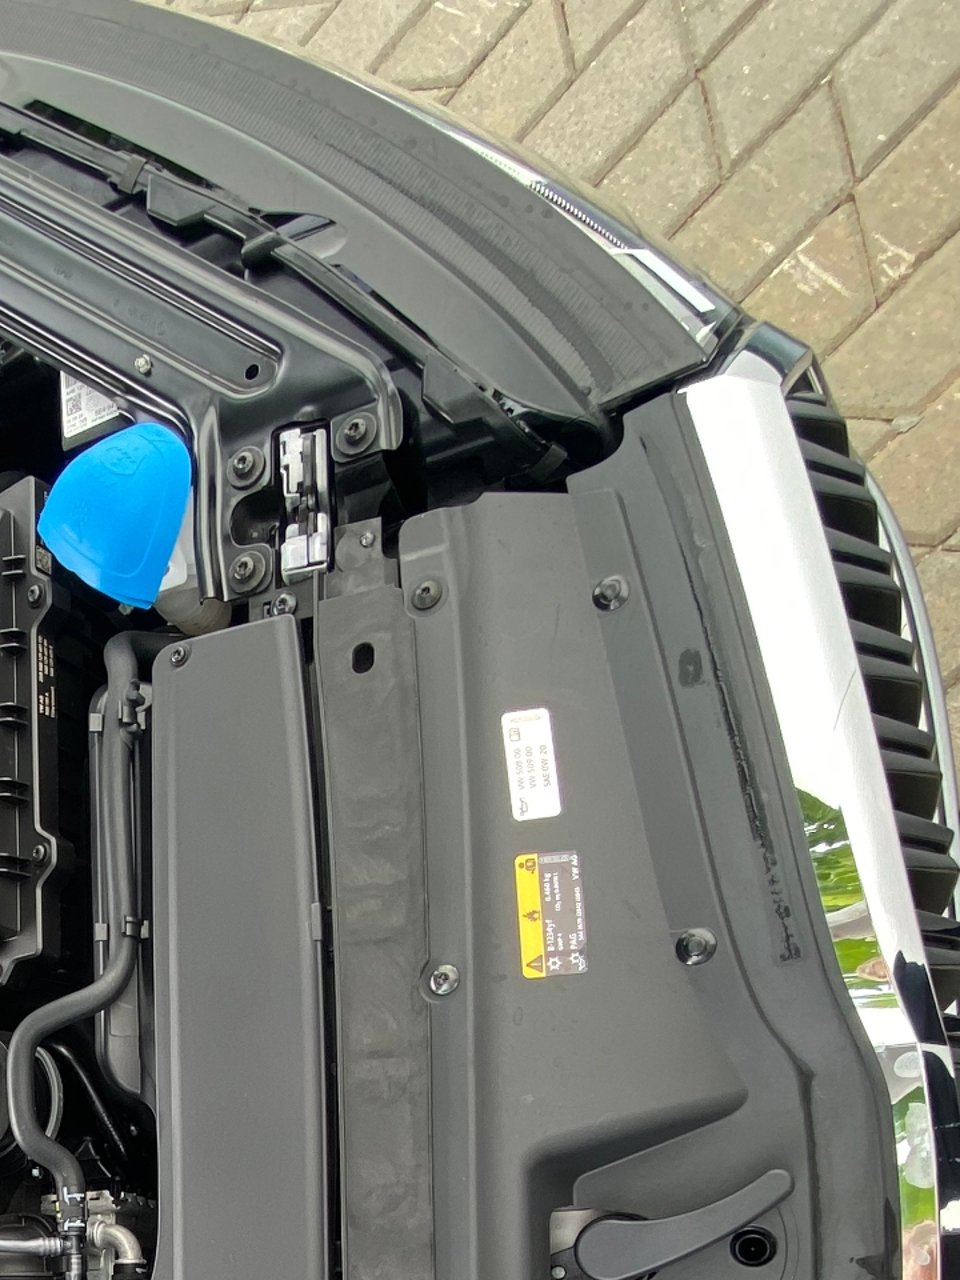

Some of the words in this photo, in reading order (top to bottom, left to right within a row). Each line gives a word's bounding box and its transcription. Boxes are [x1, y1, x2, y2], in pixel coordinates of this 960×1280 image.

[514, 747, 522, 759] 00
[525, 746, 533, 757] 00
[539, 744, 548, 755] 20
[527, 758, 535, 774] 509
[541, 758, 549, 772] 0W
[518, 777, 526, 790] VW
[529, 776, 537, 789] VW
[543, 773, 551, 787] SAE
[571, 855, 579, 866] AG
[544, 872, 552, 882] kg
[573, 867, 580, 880] VW
[570, 933, 578, 950] PAG
